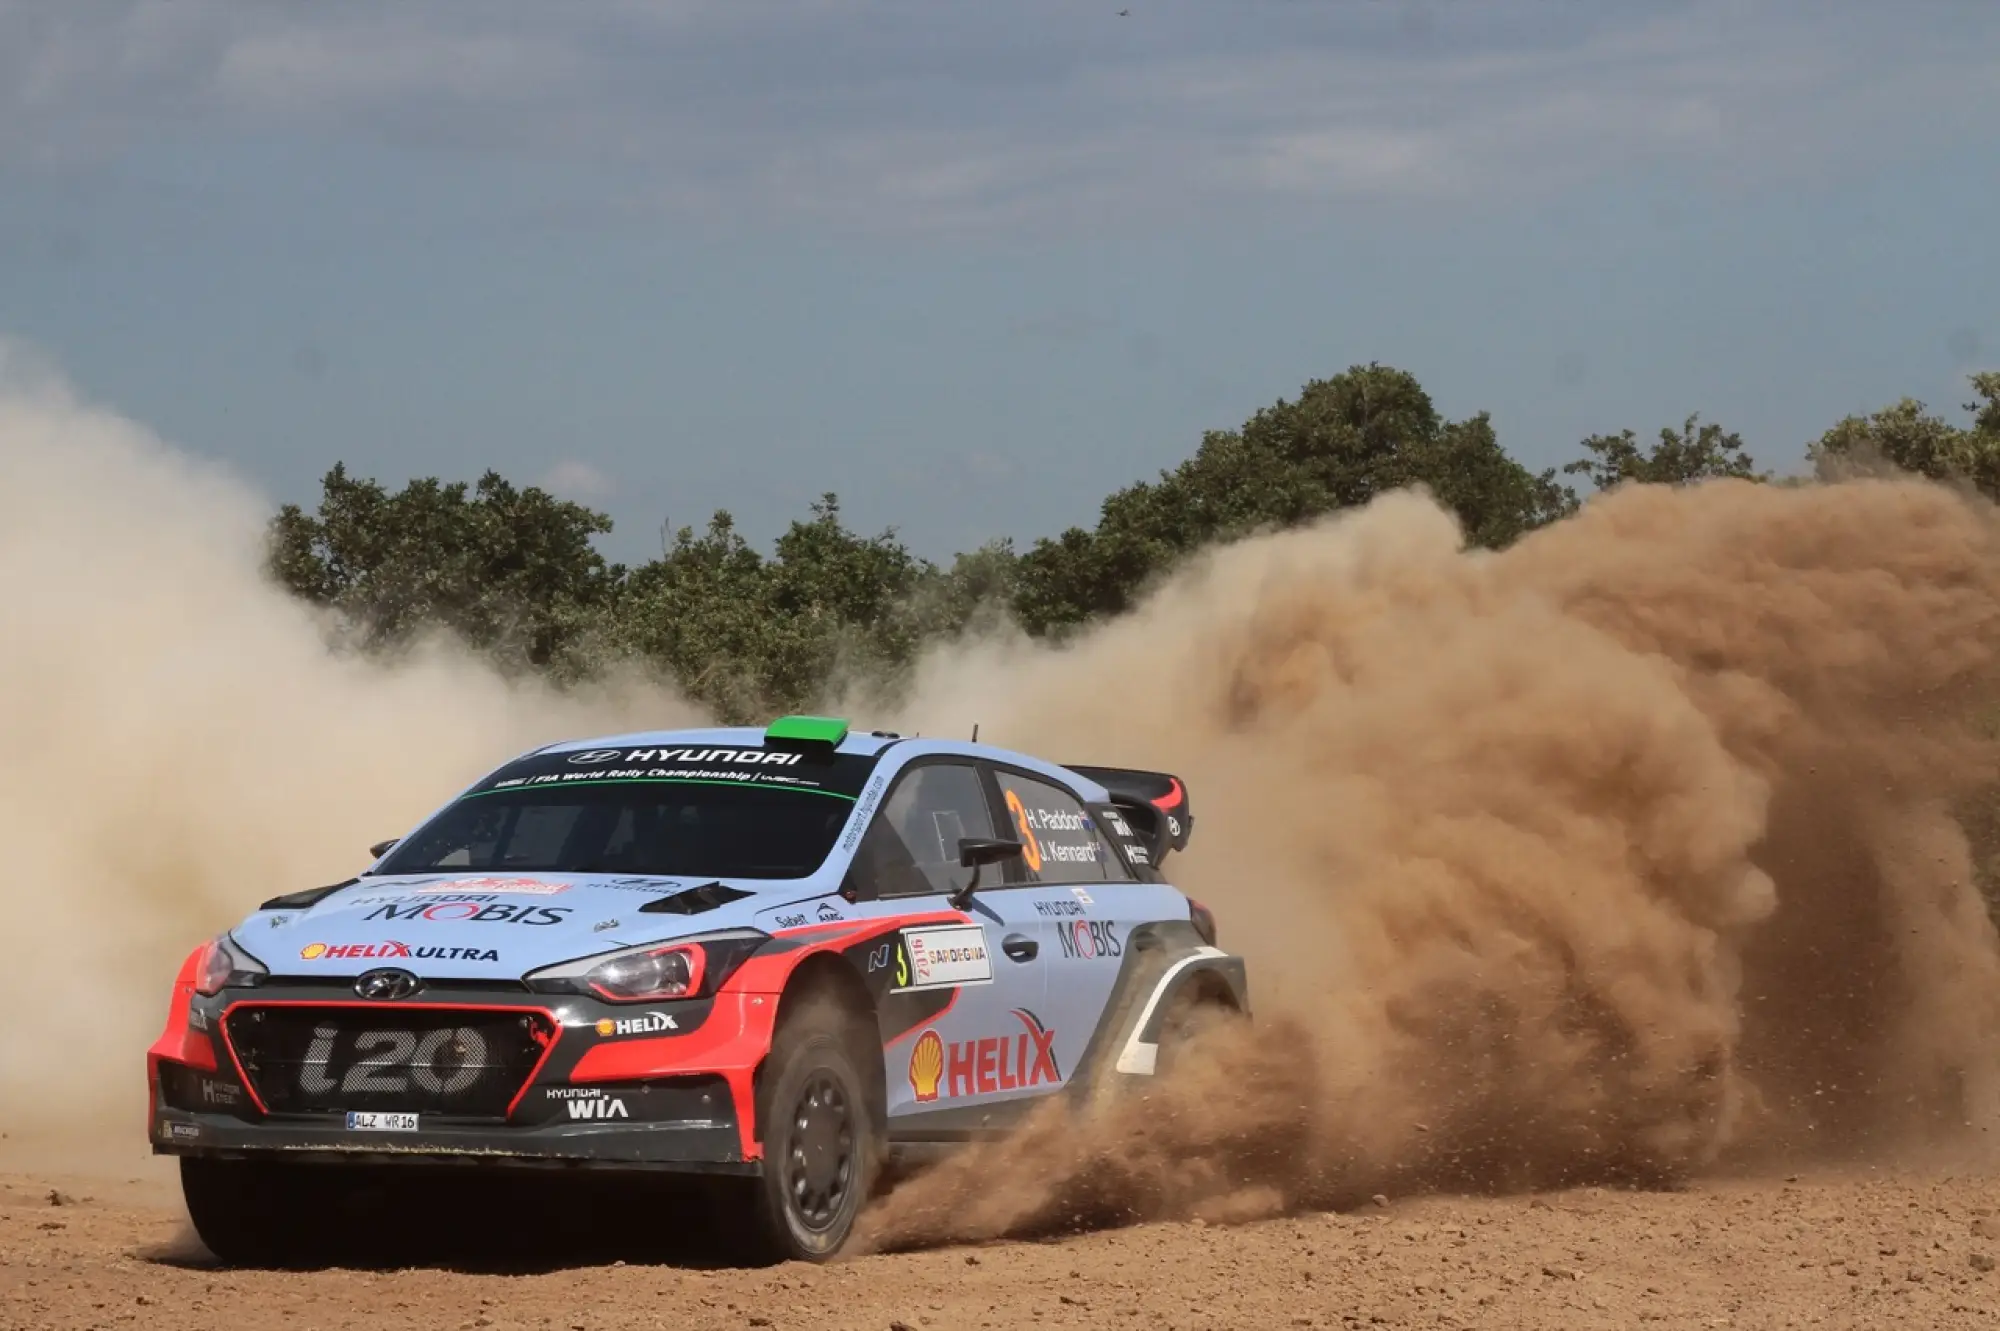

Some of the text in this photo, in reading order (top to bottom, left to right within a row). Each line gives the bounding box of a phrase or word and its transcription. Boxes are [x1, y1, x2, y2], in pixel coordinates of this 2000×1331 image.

[624, 749, 803, 765] HYUNDAI
[535, 774, 559, 783] FIA
[562, 771, 605, 780] World
[607, 769, 645, 779] Rally
[648, 769, 751, 782] Championship
[1005, 789, 1041, 871] 3
[1024, 808, 1041, 829] H.
[1038, 808, 1084, 830] Paddon
[1038, 840, 1096, 862] J. Kennard
[349, 894, 500, 905] HYUNDAI
[362, 902, 574, 926] MOBIS
[325, 940, 499, 962] HELIX ULTRA
[1056, 919, 1121, 960] MOBIS
[911, 937, 930, 978] 2016
[615, 1011, 679, 1035] HELIX
[300, 1026, 488, 1095] i20
[948, 1007, 1062, 1098] HELIX
[546, 1088, 601, 1099] HYUNDAI
